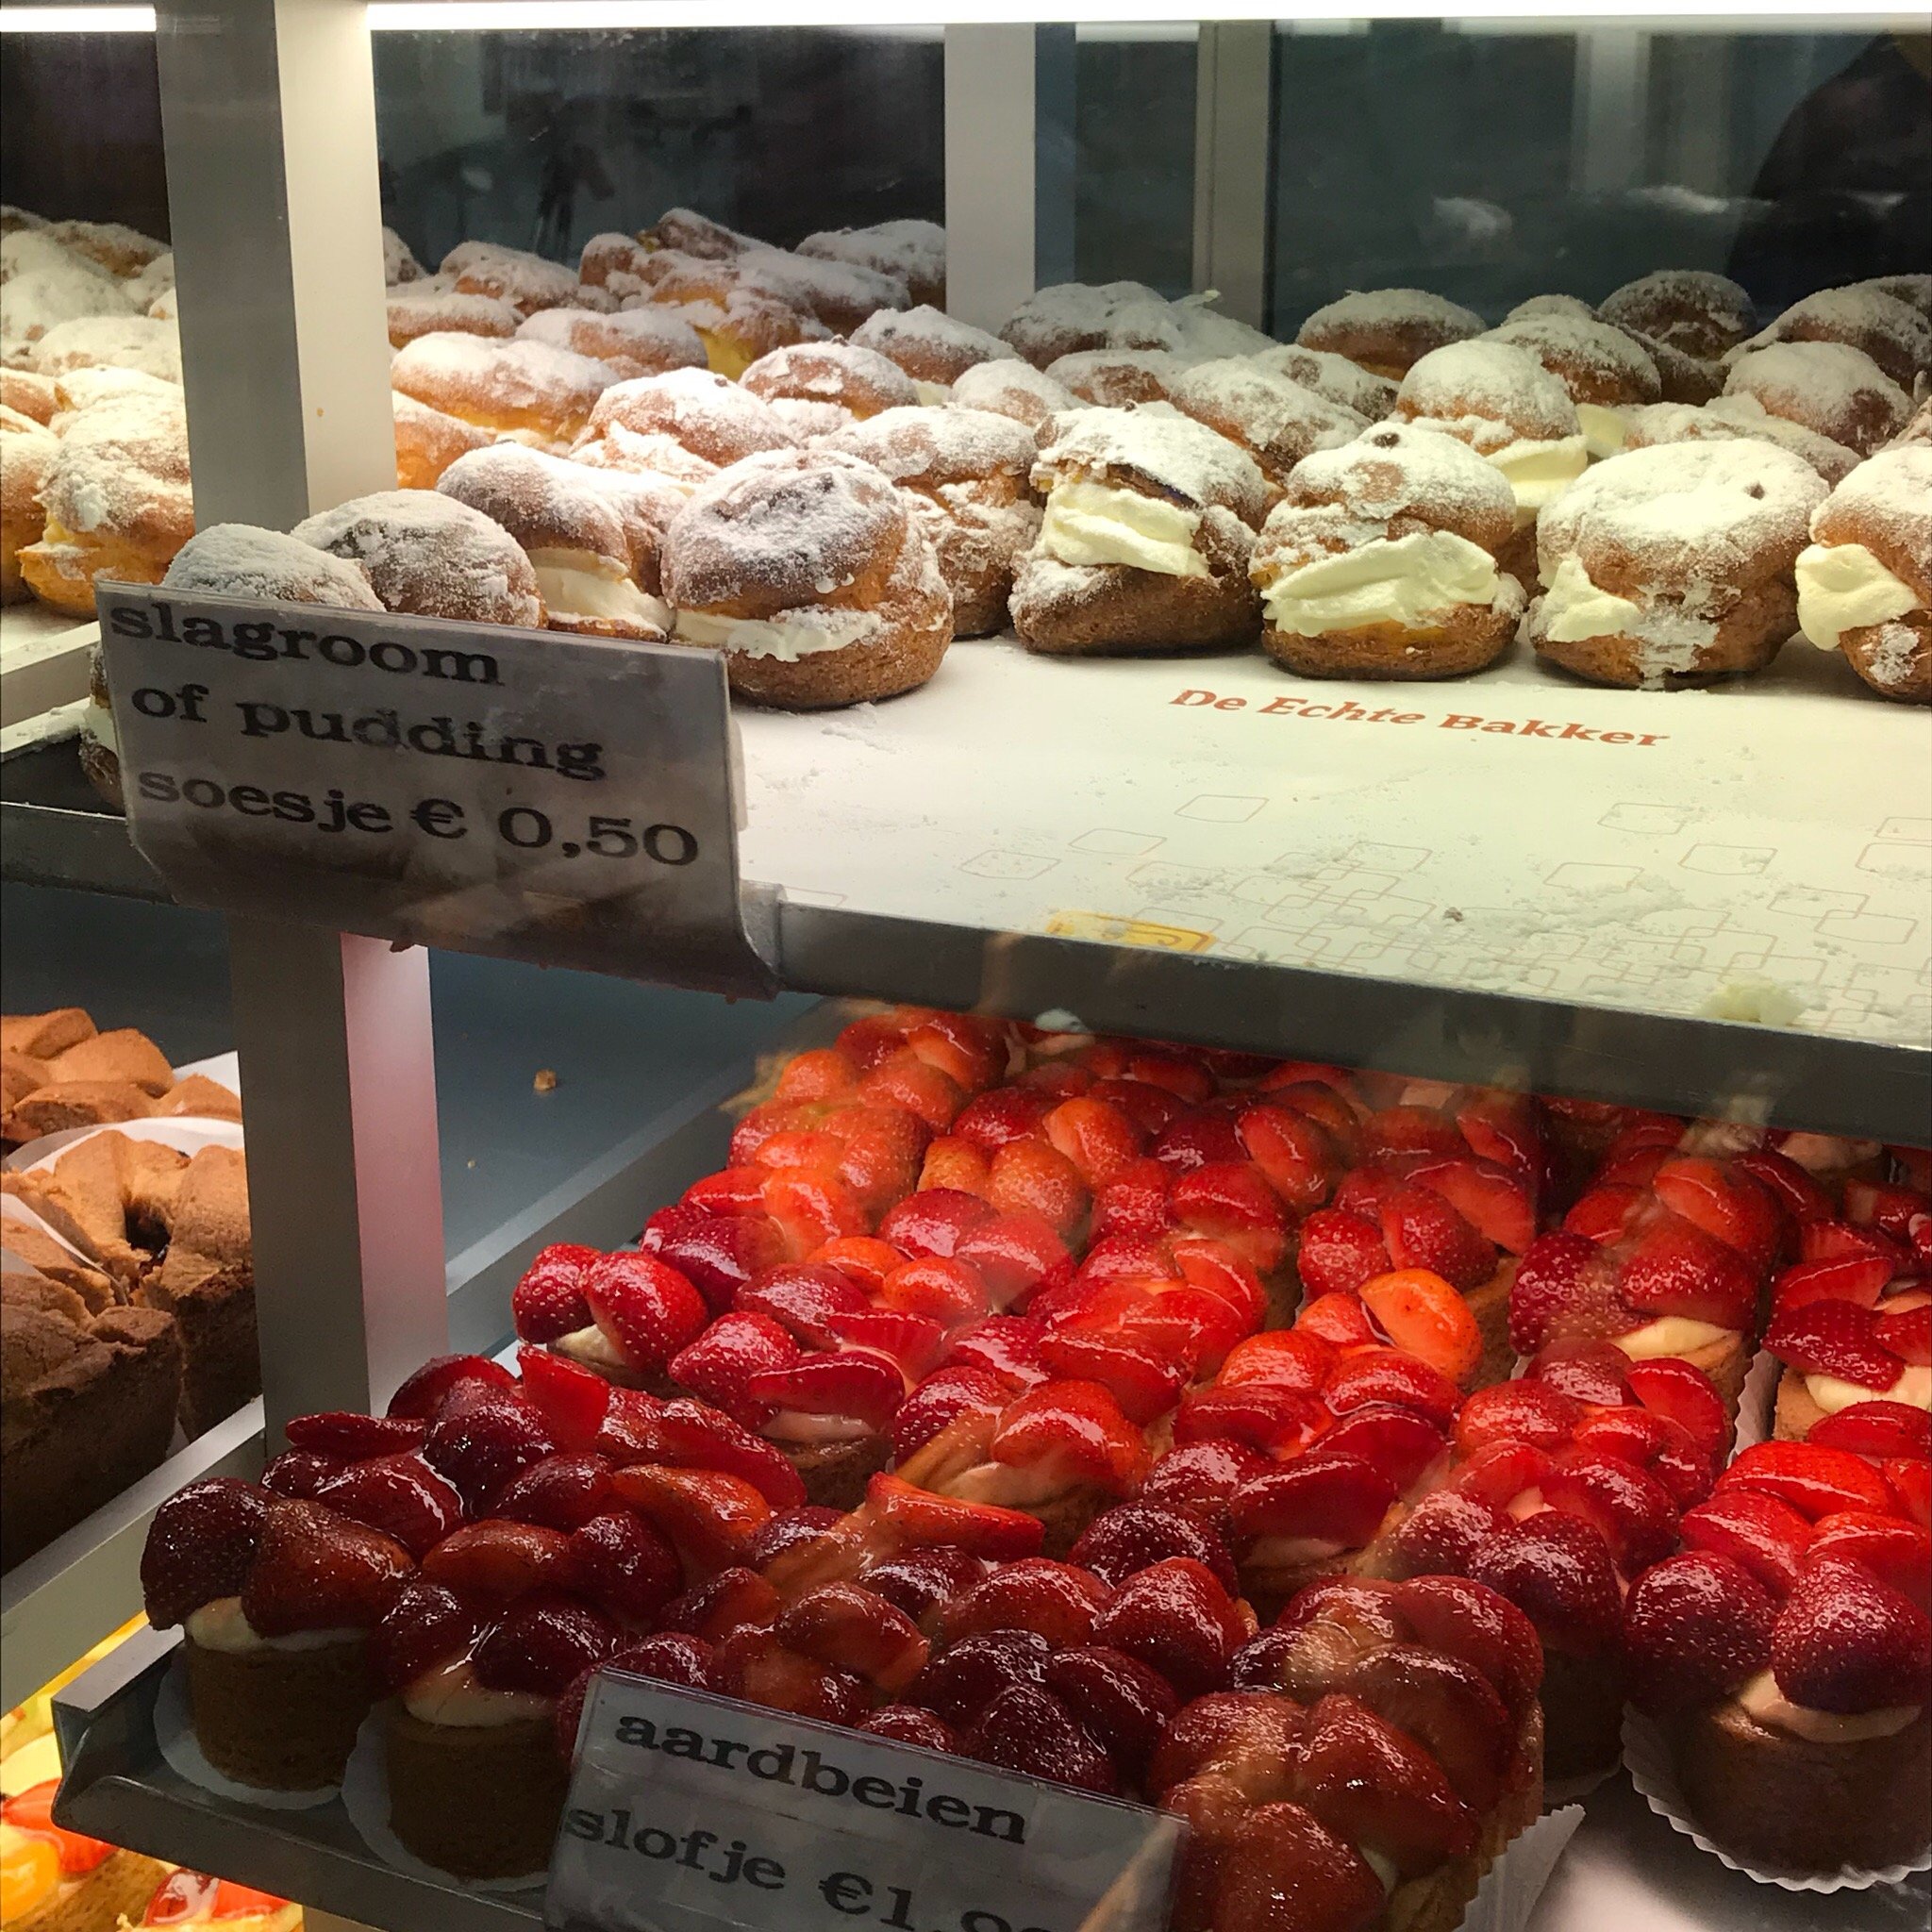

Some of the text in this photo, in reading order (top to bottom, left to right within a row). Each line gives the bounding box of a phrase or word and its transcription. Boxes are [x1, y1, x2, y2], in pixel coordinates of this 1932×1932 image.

[110, 603, 504, 685] slagroom
[131, 684, 605, 781] of pudding
[1169, 689, 1671, 746] De Echte Bakker
[139, 770, 700, 866] soesje € 0,50
[615, 1712, 1027, 1845] aardbeien
[567, 1805, 787, 1890] slofje
